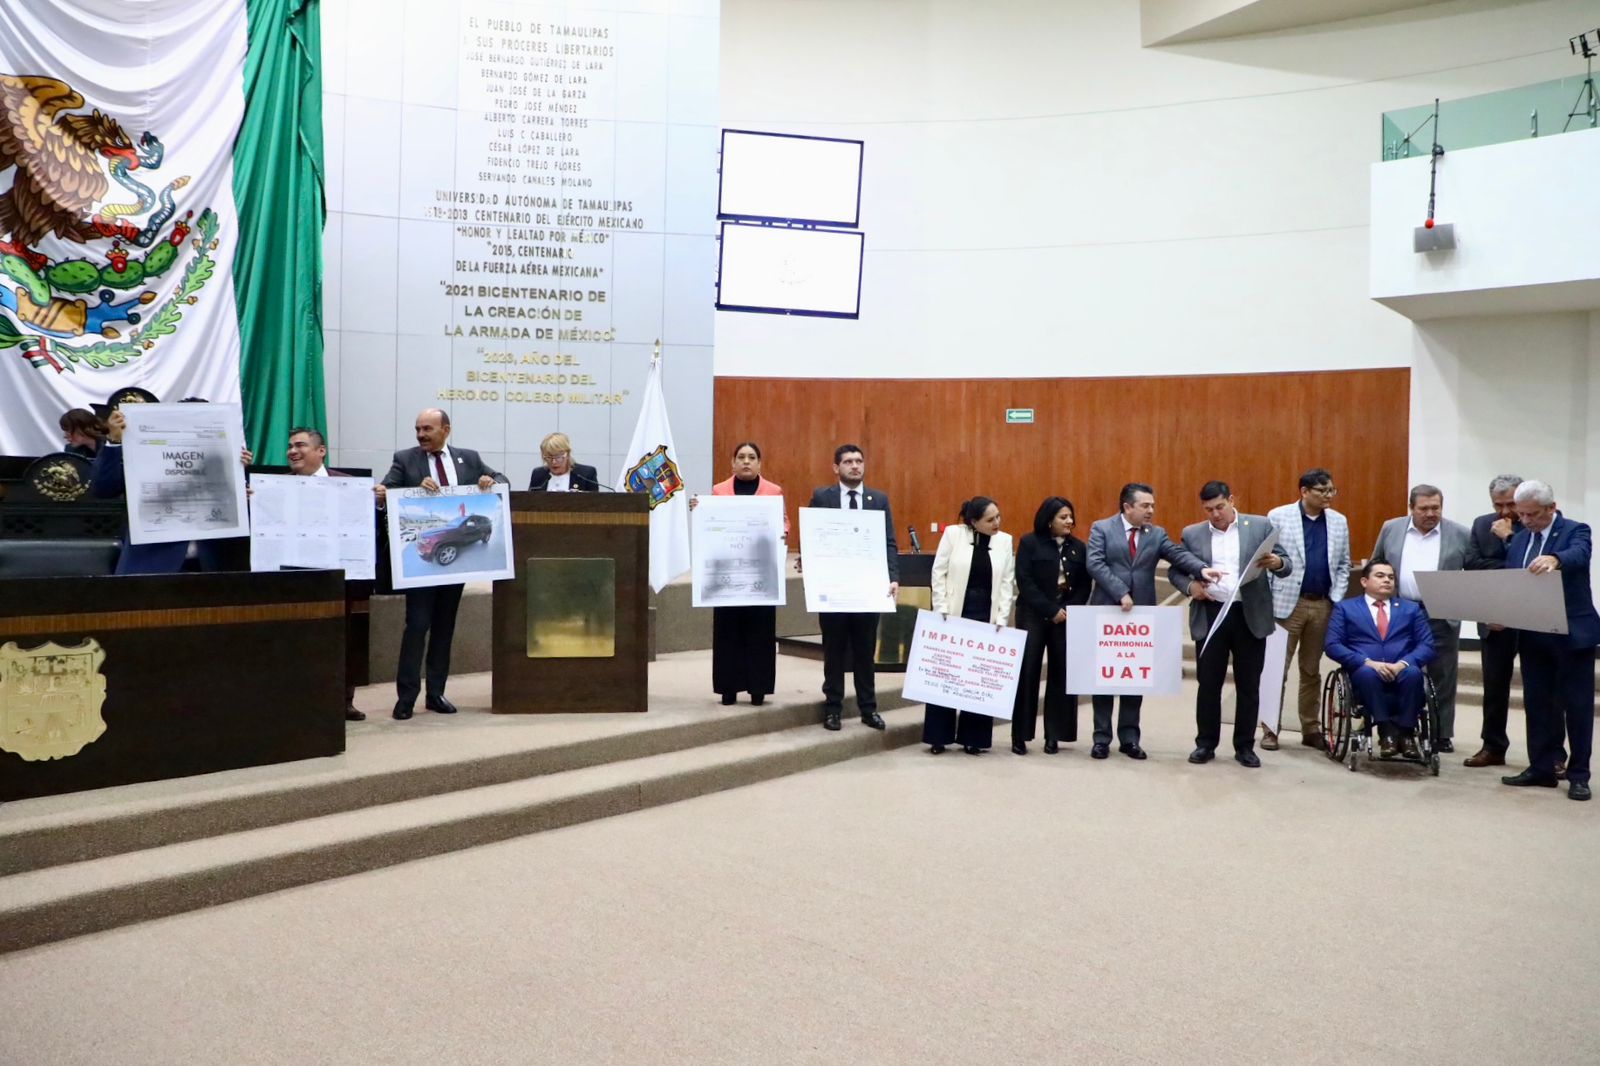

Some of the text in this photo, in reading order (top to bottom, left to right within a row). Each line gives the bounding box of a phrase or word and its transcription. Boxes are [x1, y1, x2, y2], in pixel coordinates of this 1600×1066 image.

[469, 16, 609, 38] EL PUEBLO DE TAMAULIPAS
[476, 36, 494, 48] SUS
[502, 38, 548, 52] PRÓCERES
[556, 43, 614, 57] LIBERTARIOS
[488, 54, 524, 65] BERNARDO
[572, 60, 580, 70] DE
[586, 62, 603, 70] LARA
[481, 68, 588, 84] BERNARDO GÓMEZ DE LARA
[486, 84, 586, 99] JUAN JOSÉ DE LA GARZA
[495, 98, 577, 114] PEDRO JOSÉ MÉNDEZ
[484, 112, 588, 128] ALBERTO CARRERA TORRES
[498, 128, 514, 138] LUIS
[530, 130, 572, 142] CABALLERO
[488, 141, 580, 157] CÉSAR LÓPEZ DE LARA
[488, 156, 582, 172] FIDENCIO TREJO FLORES
[478, 172, 592, 188] SERVANDO CANALES MOLANO
[436, 190, 633, 212] UNIVERSIDAD AUTÓNOMA DE TAMAULIPAS
[475, 209, 531, 225] CENTENARIO
[536, 213, 551, 226] DEL
[557, 213, 594, 228] EJÉRCITO
[598, 217, 644, 230] MEXICANO
[496, 228, 502, 240] Y
[508, 228, 545, 242] LEALTAD
[550, 231, 566, 242] POR
[456, 260, 466, 272] DE
[468, 261, 480, 273] LA
[483, 262, 517, 274] FUERZA
[520, 261, 548, 275] AÉREA
[478, 286, 584, 302] BICENTENARIO
[588, 290, 606, 302] DE
[464, 305, 582, 322] LA CREACIÓN DE
[444, 324, 464, 337] LA
[468, 326, 530, 340] ARMADA
[536, 328, 554, 340] DE
[520, 351, 551, 366] AÑO
[554, 354, 581, 366] DEL
[466, 370, 597, 386] BICENTENARIO DEL
[436, 389, 499, 402] HEROICO
[506, 392, 566, 404] COLEGIO
[162, 452, 204, 460] IMAGEN
[176, 460, 193, 469] NO
[1103, 622, 1150, 636] DAÑO
[922, 630, 1018, 657] IMPLICADOS
